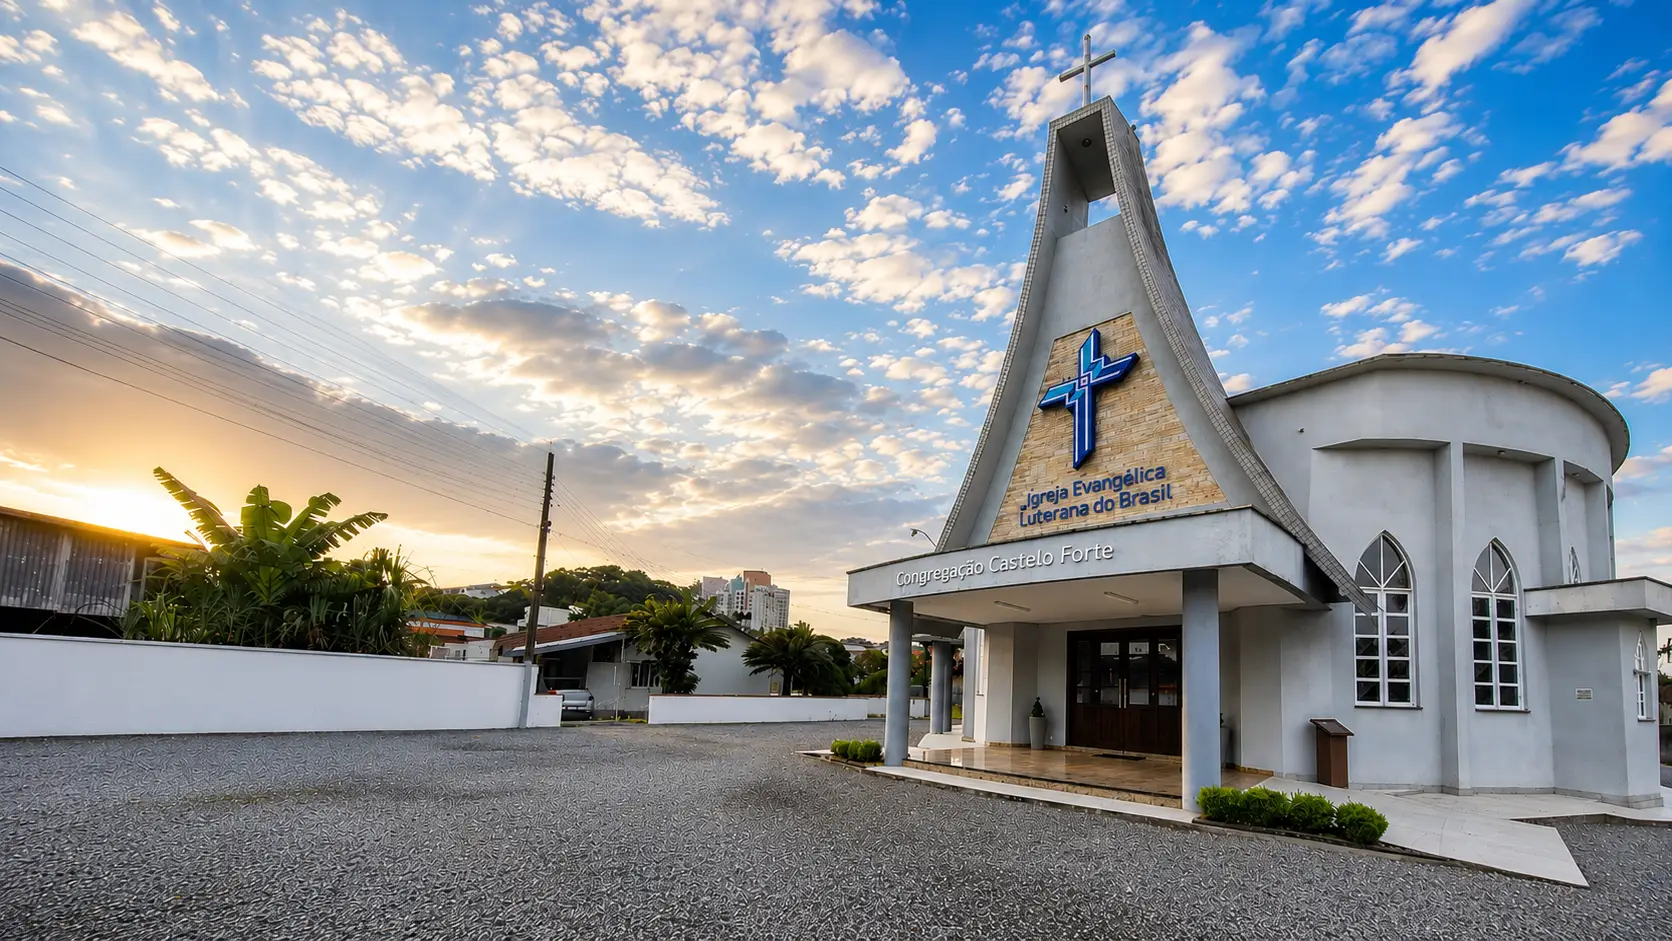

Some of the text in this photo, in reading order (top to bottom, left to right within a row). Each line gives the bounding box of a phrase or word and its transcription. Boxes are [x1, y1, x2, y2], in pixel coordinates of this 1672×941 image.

[1020, 483, 1173, 527] Luterana do Brasil
[1027, 465, 1166, 509] Igreja Evangélica
[896, 543, 1114, 587] Congregação Castelo Forte
